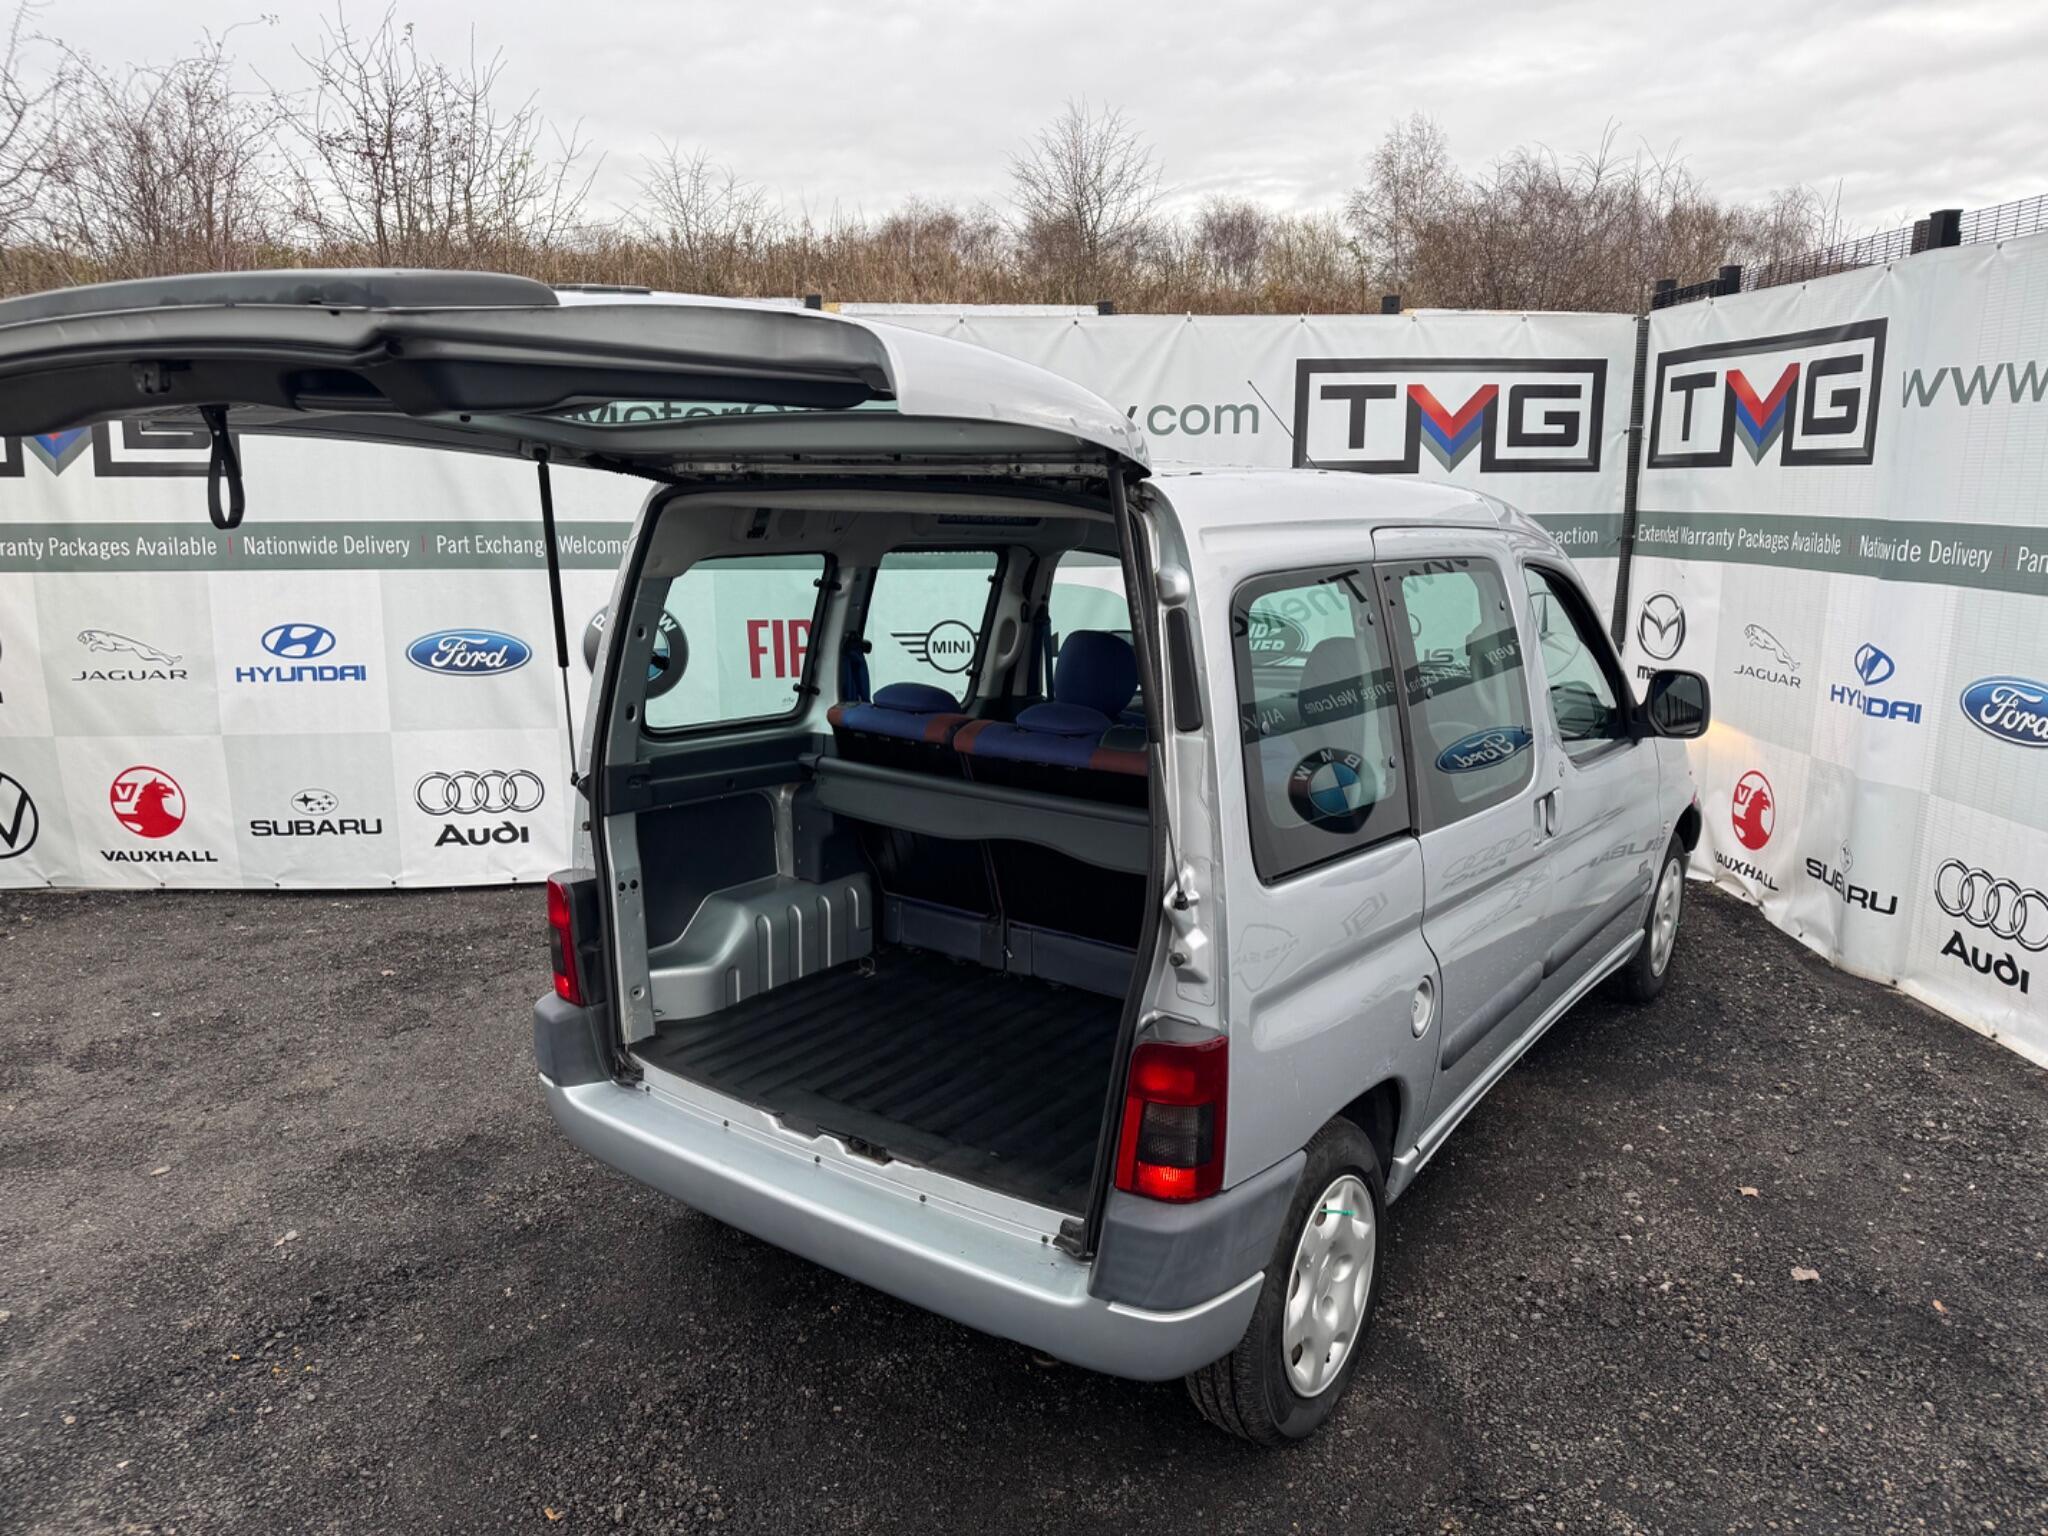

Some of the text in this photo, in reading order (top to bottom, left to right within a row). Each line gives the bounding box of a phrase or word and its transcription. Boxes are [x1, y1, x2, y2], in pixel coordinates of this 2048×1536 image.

[1670, 354, 1864, 466] TMG
[1320, 384, 1583, 473] TMG
[49, 537, 130, 560] Packages
[136, 537, 217, 556] Available
[243, 535, 338, 555] Nationwide
[343, 535, 410, 557] Delivery
[436, 535, 471, 554] Part
[475, 535, 546, 557] Exchang
[557, 535, 629, 555] Welcome
[1638, 524, 1679, 544] Extended
[1680, 526, 1735, 550] Warranty
[1738, 528, 1789, 553] Packages
[1791, 531, 1842, 554] Available
[1929, 540, 1992, 573] Delivery
[430, 637, 509, 670] Ford
[932, 640, 971, 654] MINI
[72, 669, 188, 681] JAGUAR
[236, 664, 367, 683] HYUNDAI
[1733, 664, 1801, 689] JAGUAR
[250, 818, 382, 837] SUBARU
[435, 822, 530, 846] Audi
[100, 849, 218, 863] VAUXHALL
[1714, 848, 1779, 891] VAUXHALL
[1941, 929, 2029, 994] Audi
